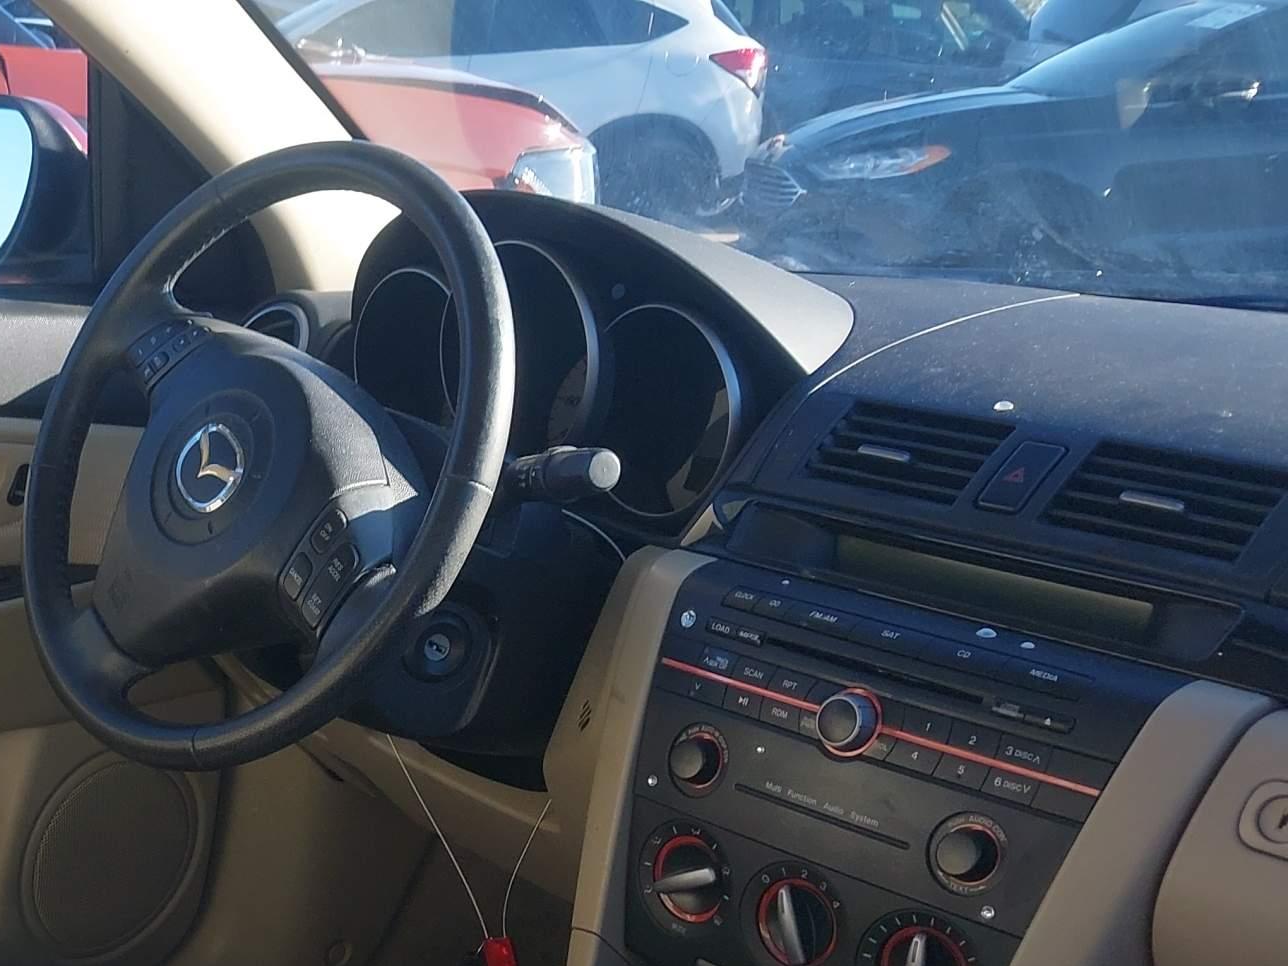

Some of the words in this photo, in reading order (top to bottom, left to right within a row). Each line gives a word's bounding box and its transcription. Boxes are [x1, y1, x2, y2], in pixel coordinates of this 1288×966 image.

[711, 623, 730, 634] LOAD
[880, 629, 901, 640] SAT
[956, 650, 971, 659] CD
[743, 667, 764, 680] SCAN
[1029, 668, 1058, 682] MEDIA
[782, 679, 798, 690] RPT
[772, 707, 788, 720] RDM
[968, 736, 977, 746] 2
[911, 750, 919, 761] 4
[1005, 746, 1014, 756] 3
[1014, 749, 1034, 761] DISC
[957, 765, 965, 776] 5
[994, 776, 1002, 787] 6
[1003, 780, 1022, 792] DISC
[787, 789, 817, 806] Function
[851, 810, 879, 827] System
[801, 868, 809, 879] 2
